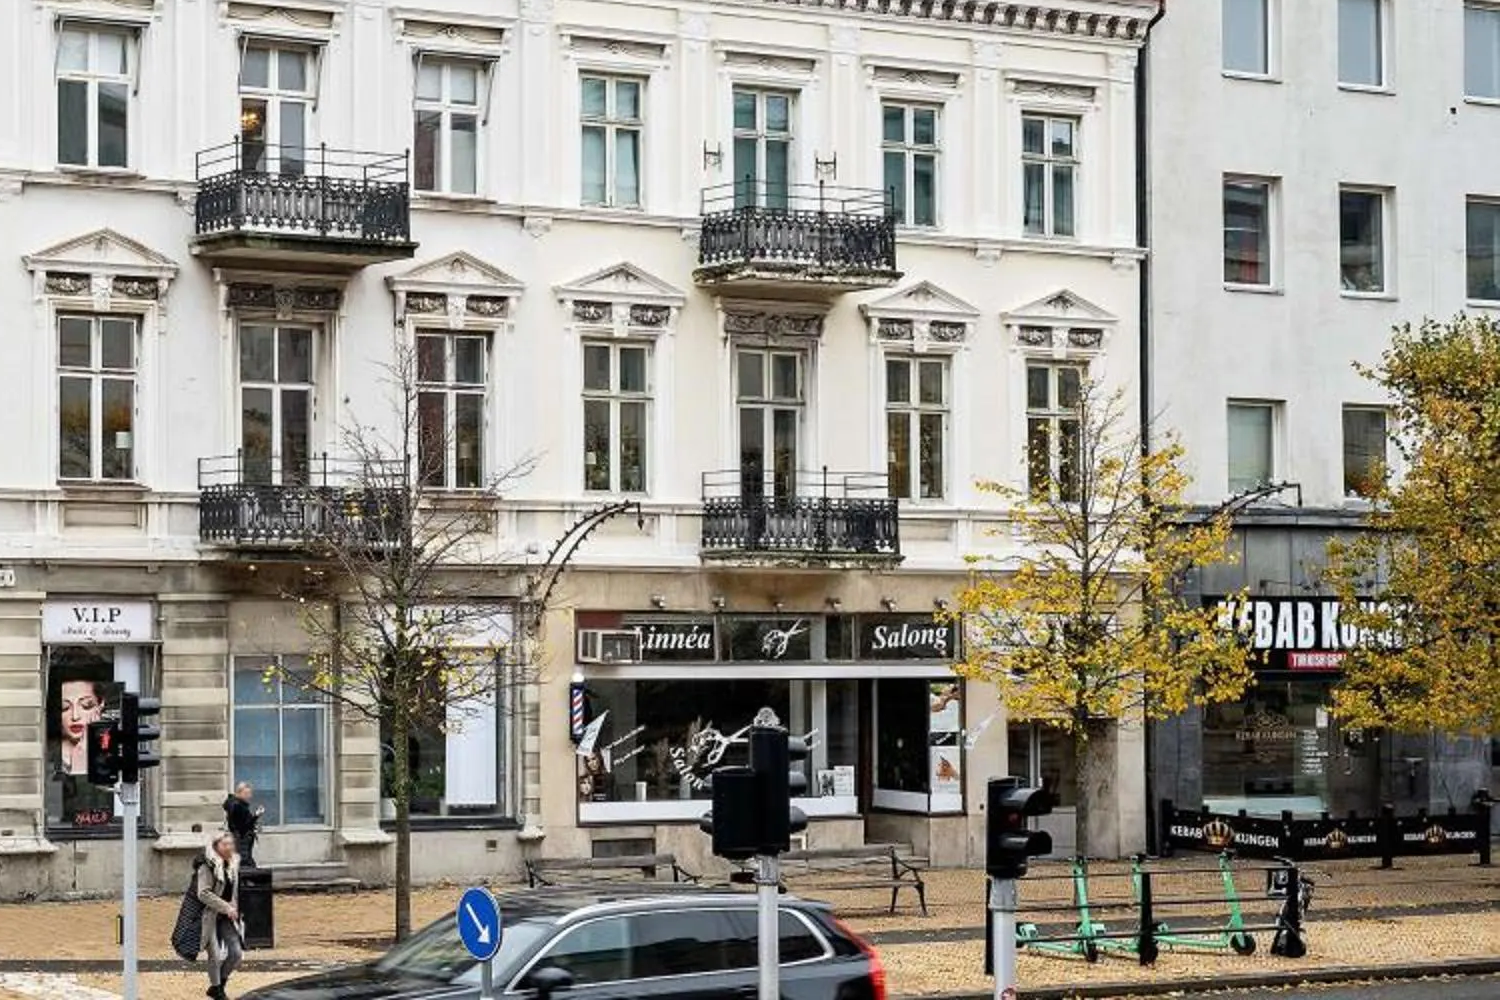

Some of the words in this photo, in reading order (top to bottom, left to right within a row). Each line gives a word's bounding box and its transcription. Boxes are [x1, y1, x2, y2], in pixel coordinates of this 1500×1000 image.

[72, 607, 121, 622] V.I.P
[871, 623, 949, 656] Salong
[1171, 825, 1203, 839] KEBAB
[1235, 832, 1279, 848] KUNGEN
